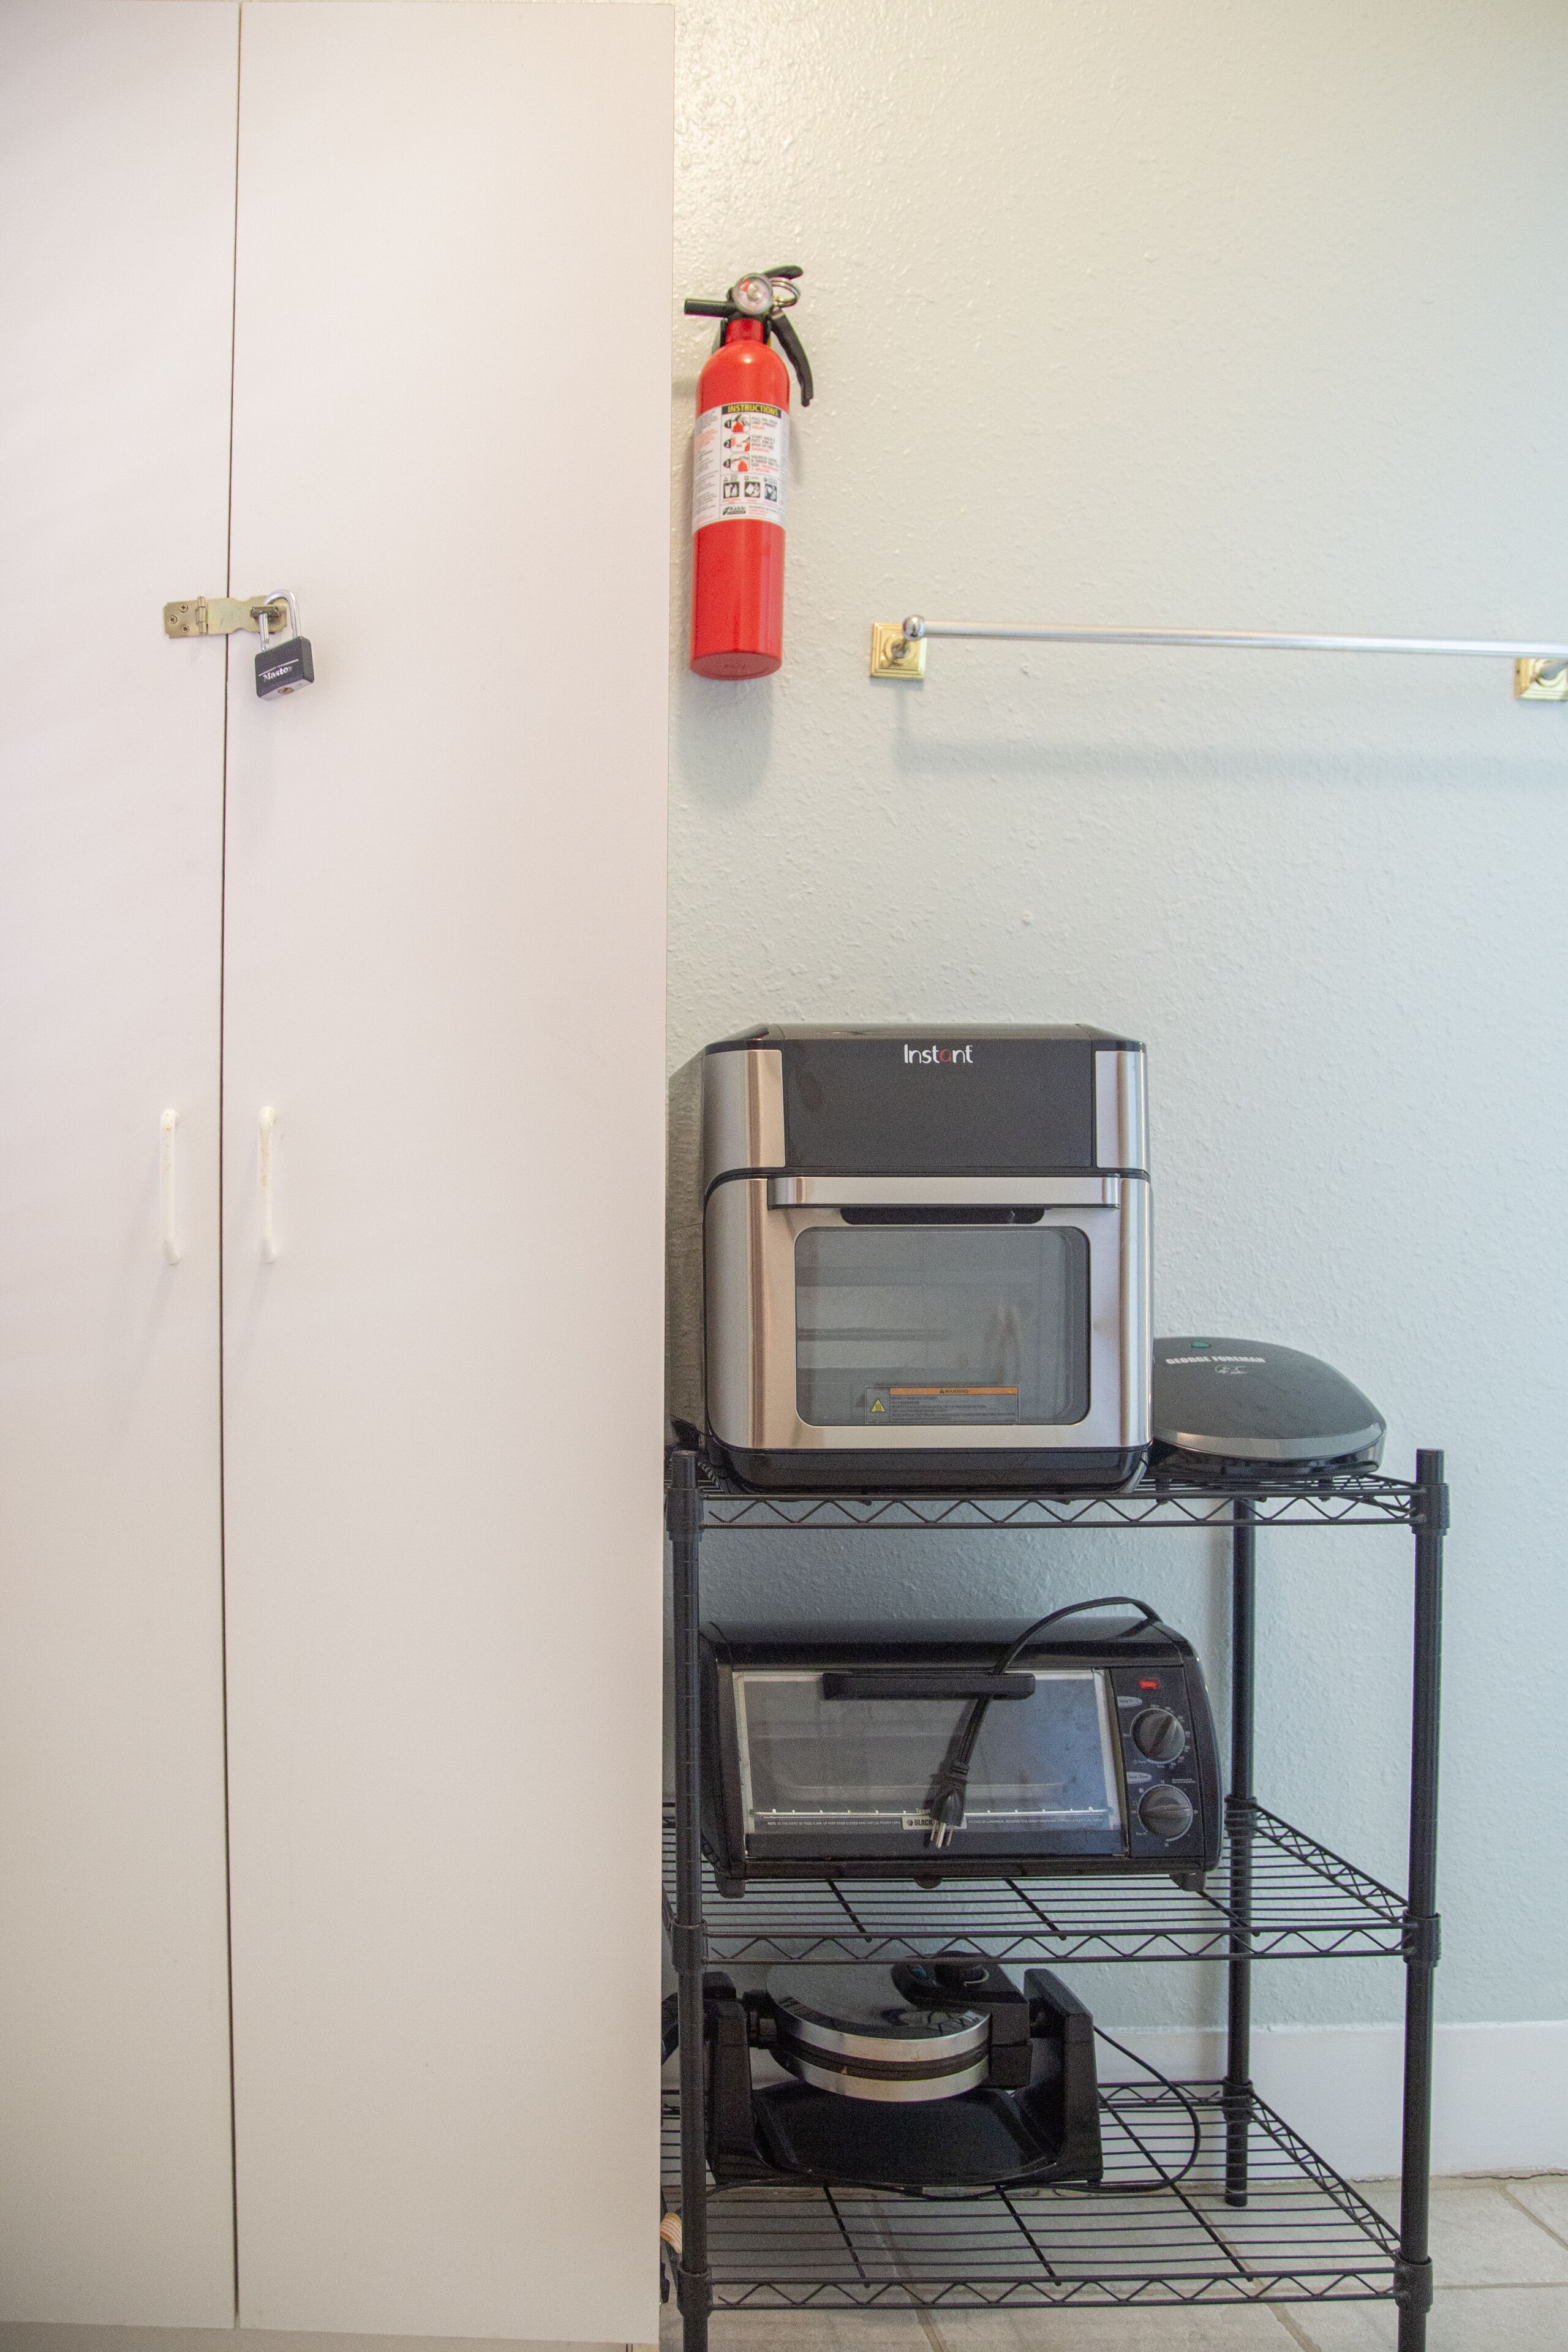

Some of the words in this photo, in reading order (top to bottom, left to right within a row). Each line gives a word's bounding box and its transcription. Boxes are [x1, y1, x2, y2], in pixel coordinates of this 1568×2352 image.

[728, 404, 778, 417] INSTRUCTIONS
[904, 1044, 973, 1064] Instant
[1166, 1355, 1212, 1365] GEORGE
